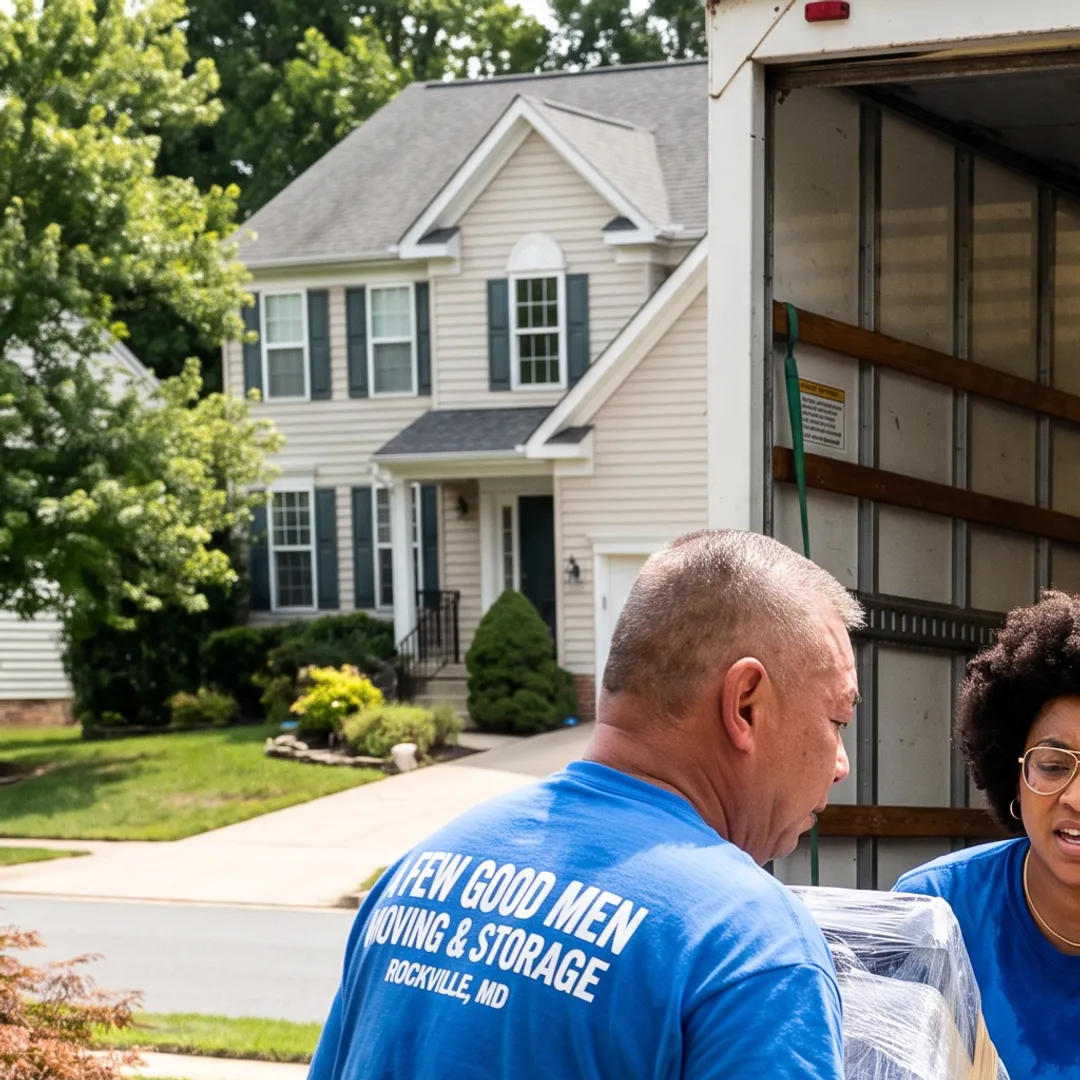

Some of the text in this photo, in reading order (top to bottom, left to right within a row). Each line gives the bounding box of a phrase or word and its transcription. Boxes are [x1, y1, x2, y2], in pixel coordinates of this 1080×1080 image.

[396, 851, 473, 902] FEW
[461, 859, 556, 919] GOOD
[543, 880, 649, 956] MEN
[364, 904, 610, 1004] MOVING & STORAGE
[384, 958, 510, 1010] ROCKVILLE, MD
